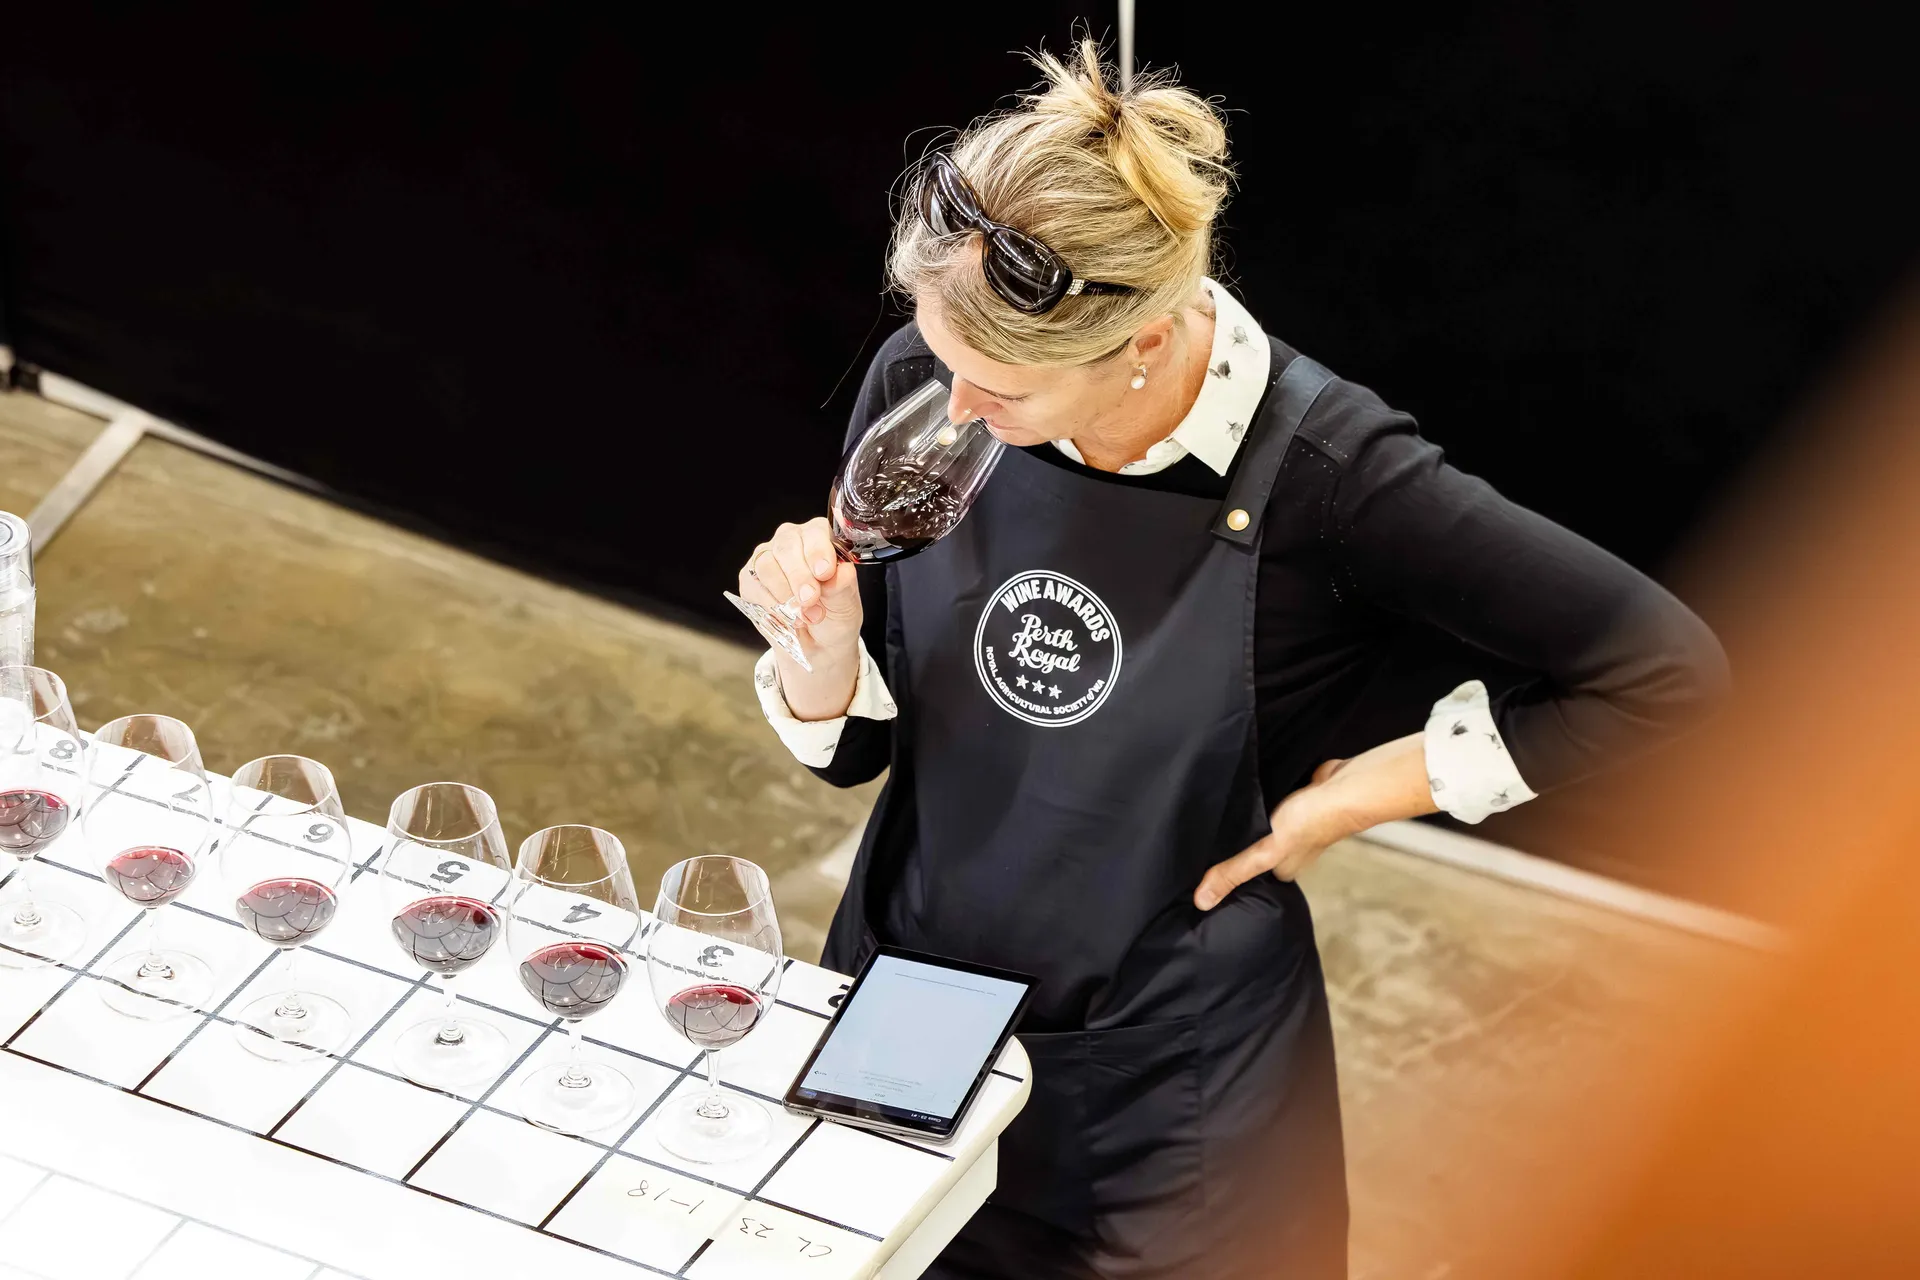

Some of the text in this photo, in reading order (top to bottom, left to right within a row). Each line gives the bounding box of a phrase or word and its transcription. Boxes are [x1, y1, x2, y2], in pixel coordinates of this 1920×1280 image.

[1000, 579, 1111, 642] WINE AWARDS
[1020, 613, 1078, 652] Perth
[1008, 632, 1081, 674] Royal
[985, 646, 998, 678] ROYAL
[994, 676, 1052, 715] AGRICULTURAL
[1053, 696, 1088, 715] SOCIETY
[1092, 679, 1106, 694] WA
[49, 739, 78, 761] 8
[430, 860, 471, 884] 5
[562, 902, 602, 924] 4
[697, 944, 735, 968] 3
[627, 1179, 705, 1215] 1-18
[739, 1217, 832, 1258] CL 23
